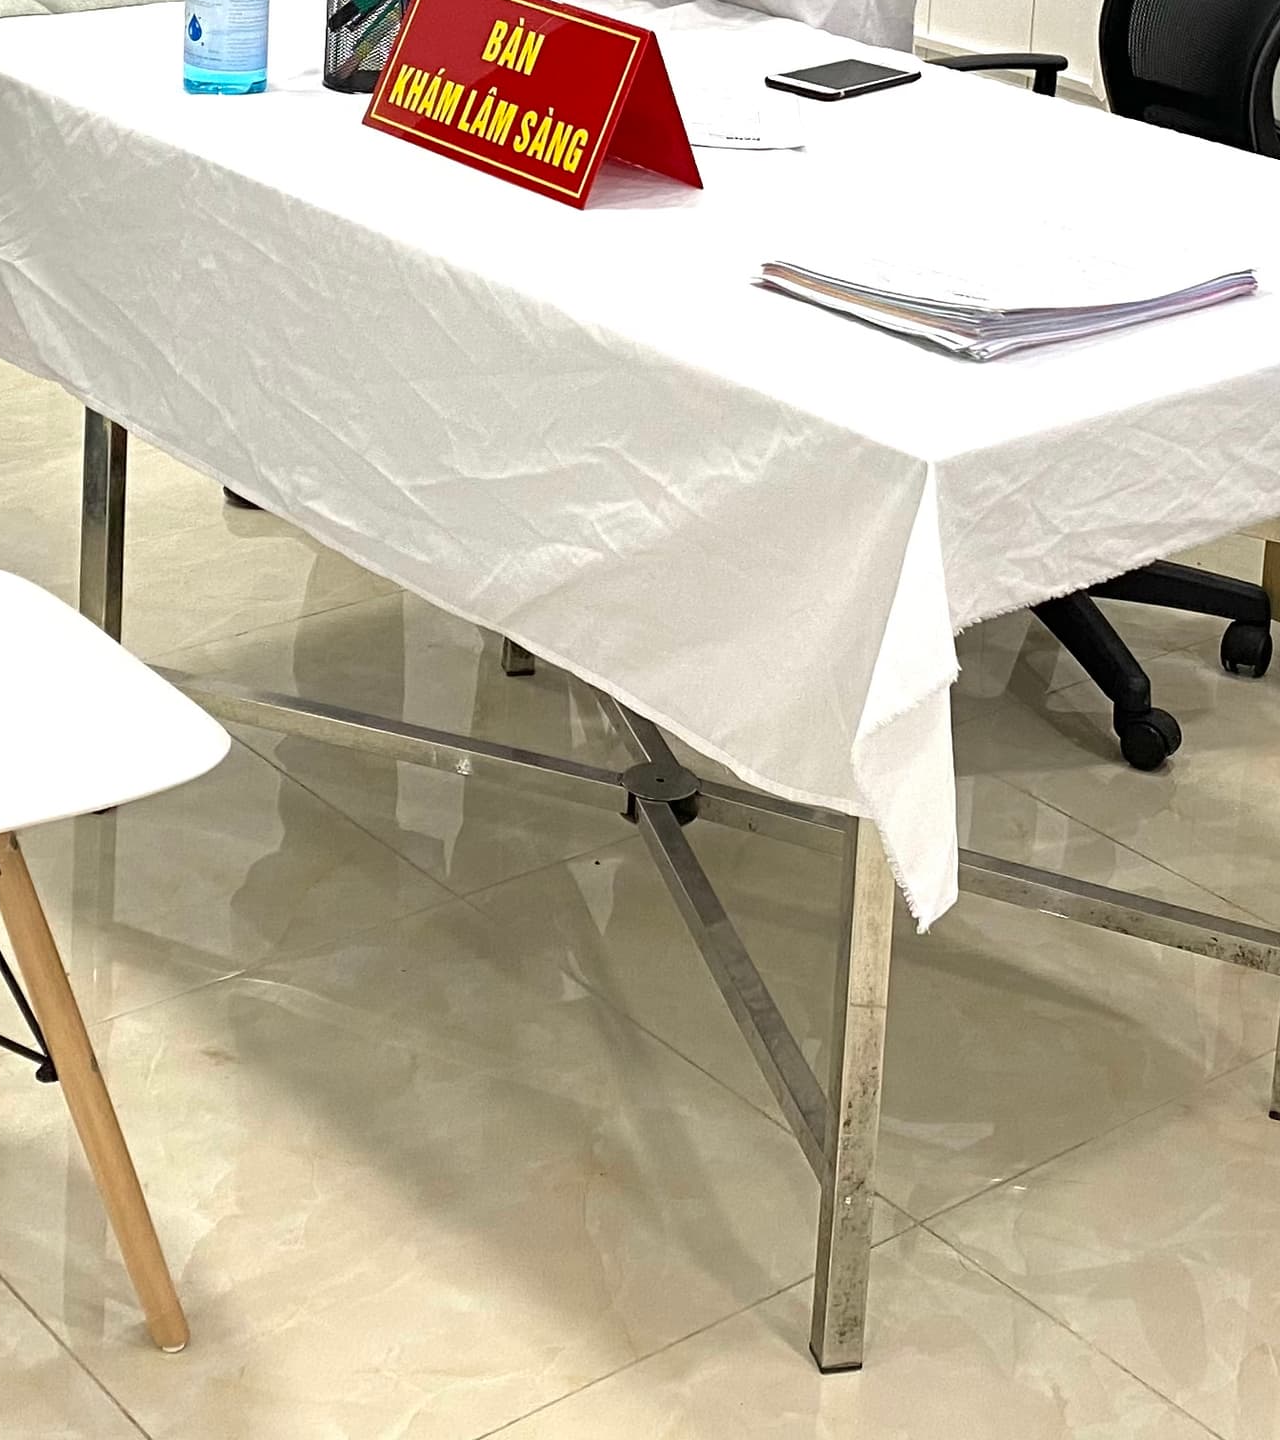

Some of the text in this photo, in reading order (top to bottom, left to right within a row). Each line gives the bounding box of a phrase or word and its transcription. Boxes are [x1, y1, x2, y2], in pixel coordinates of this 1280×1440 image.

[481, 17, 545, 76] BÀN
[388, 64, 589, 174] KHÁM LÂM SÀNG
